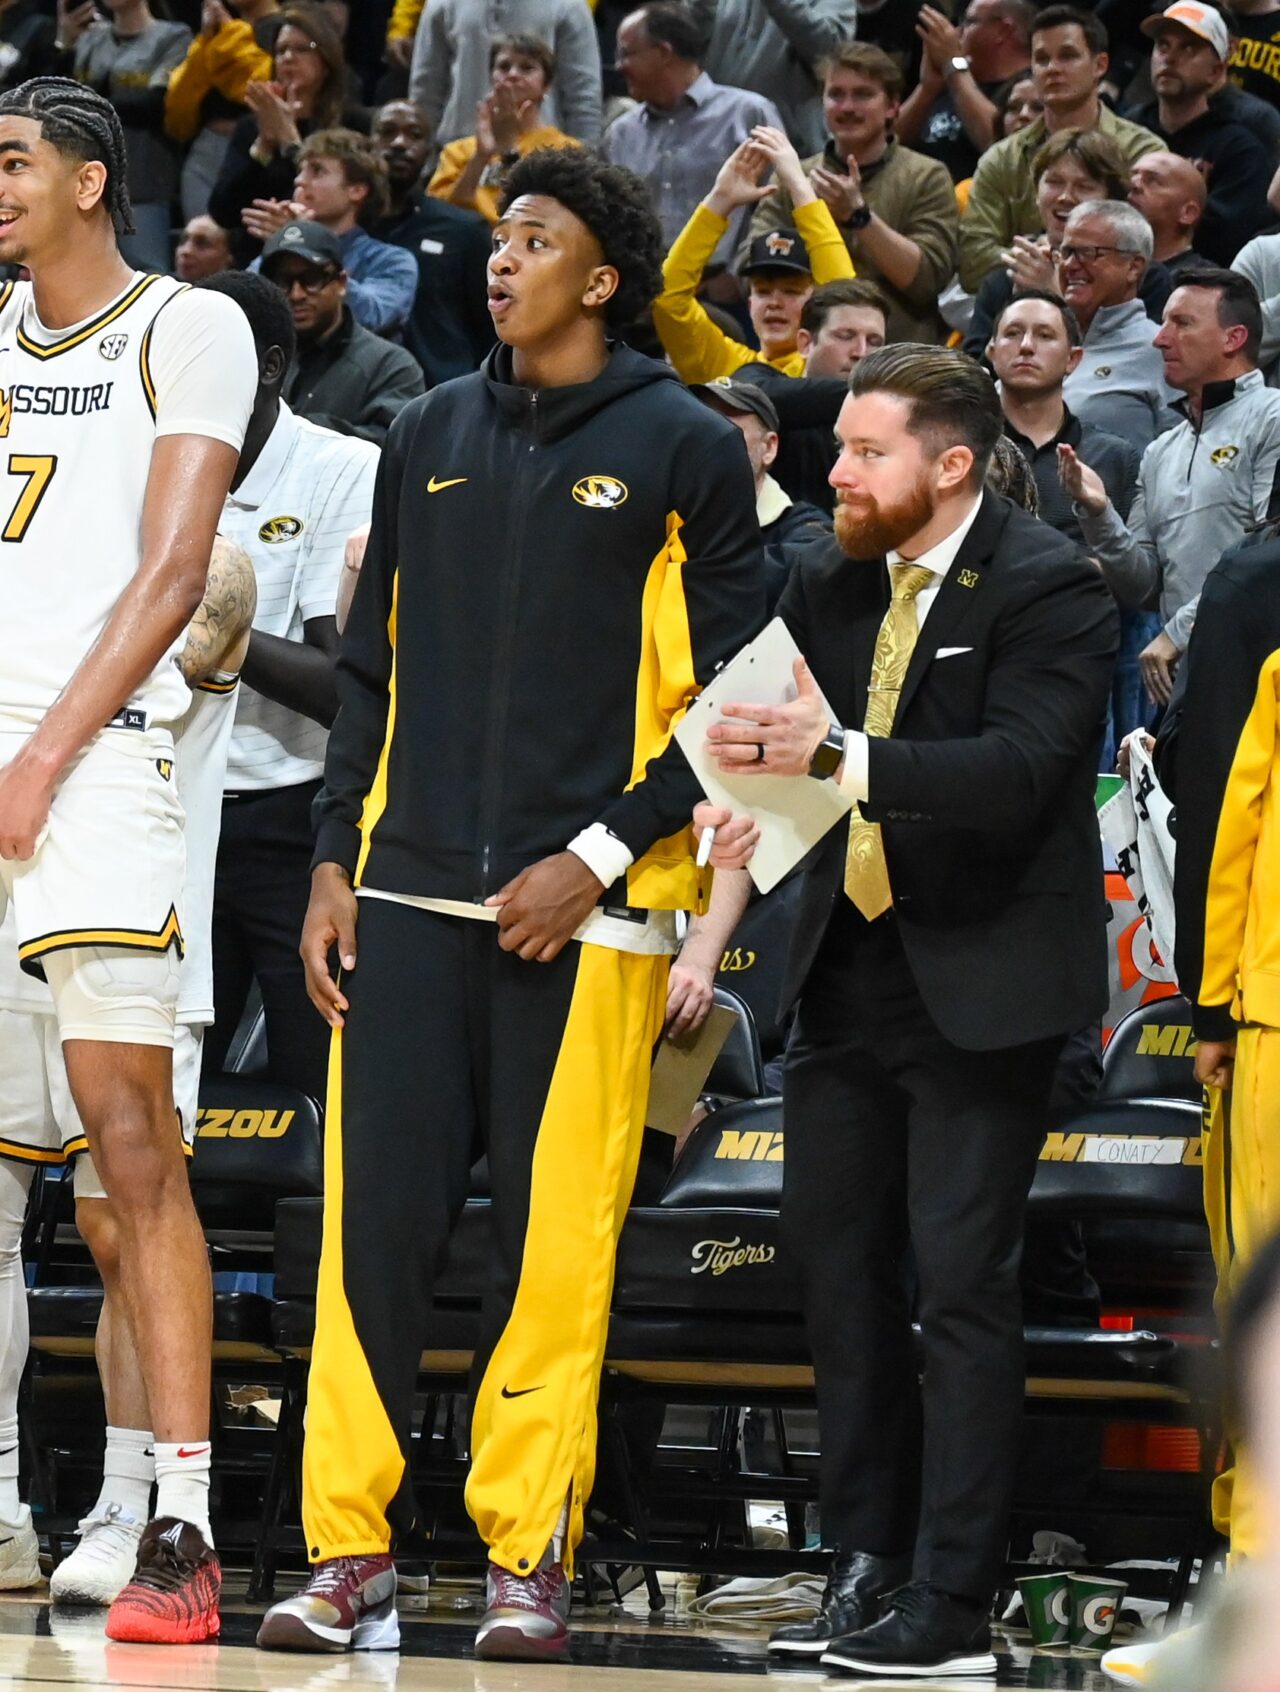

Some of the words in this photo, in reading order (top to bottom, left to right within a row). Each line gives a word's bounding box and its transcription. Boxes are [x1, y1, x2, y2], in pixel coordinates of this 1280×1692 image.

[1, 454, 58, 543] 7
[128, 714, 142, 725] XL
[1097, 1138, 1164, 1163] CONATY
[691, 1236, 776, 1276] Tigers
[1083, 1596, 1117, 1636] G
